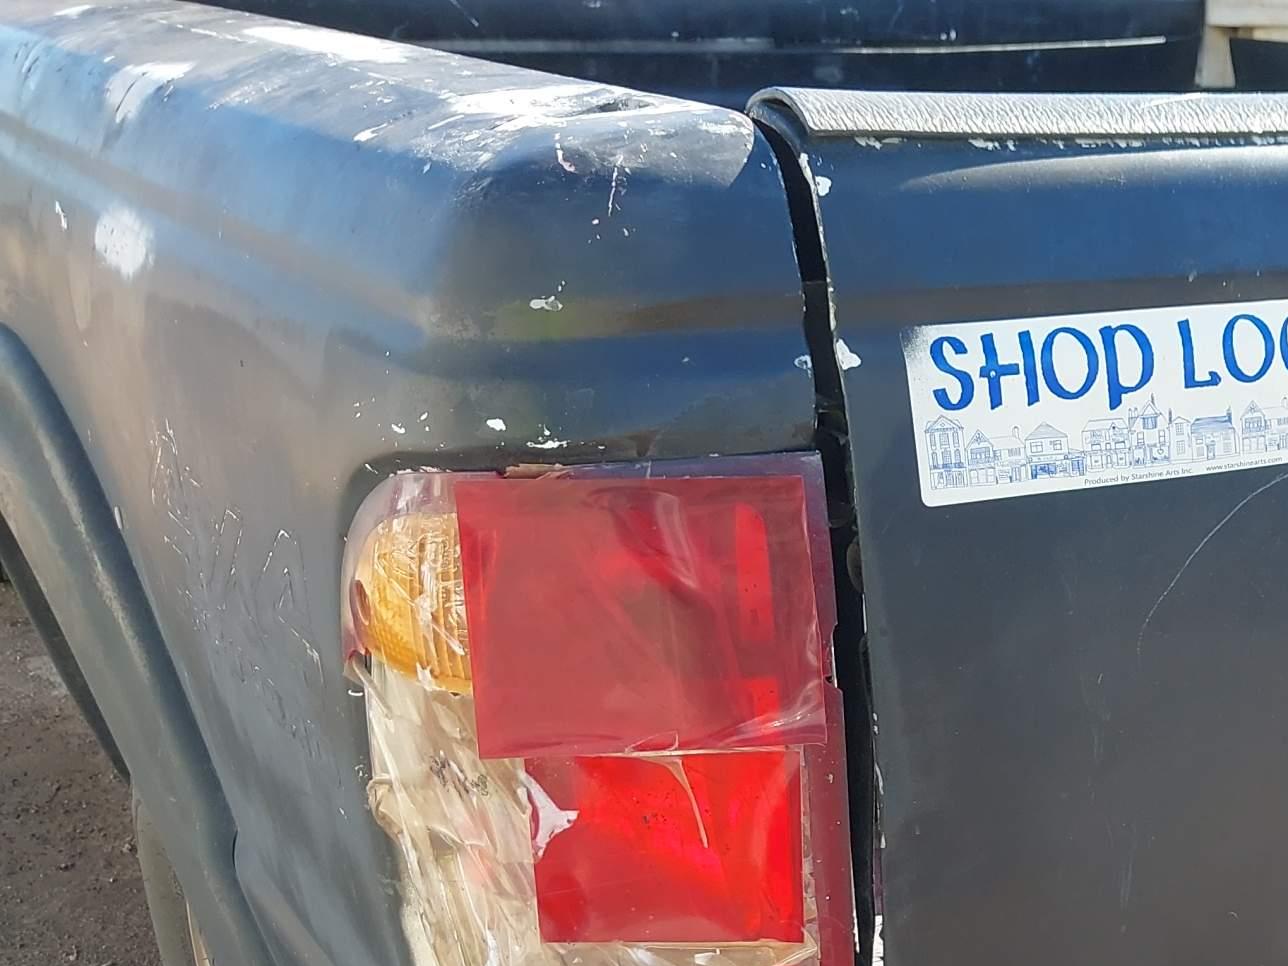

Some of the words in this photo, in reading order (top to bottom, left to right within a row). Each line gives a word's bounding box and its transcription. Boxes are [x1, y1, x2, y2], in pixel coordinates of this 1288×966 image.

[929, 324, 1154, 410] SHOP
[1205, 456, 1283, 472] www.starshinearts.com
[1084, 474, 1119, 486] Produced
[1120, 473, 1130, 482] by
[1131, 471, 1164, 481] Starshine
[1165, 468, 1180, 477] Arts
